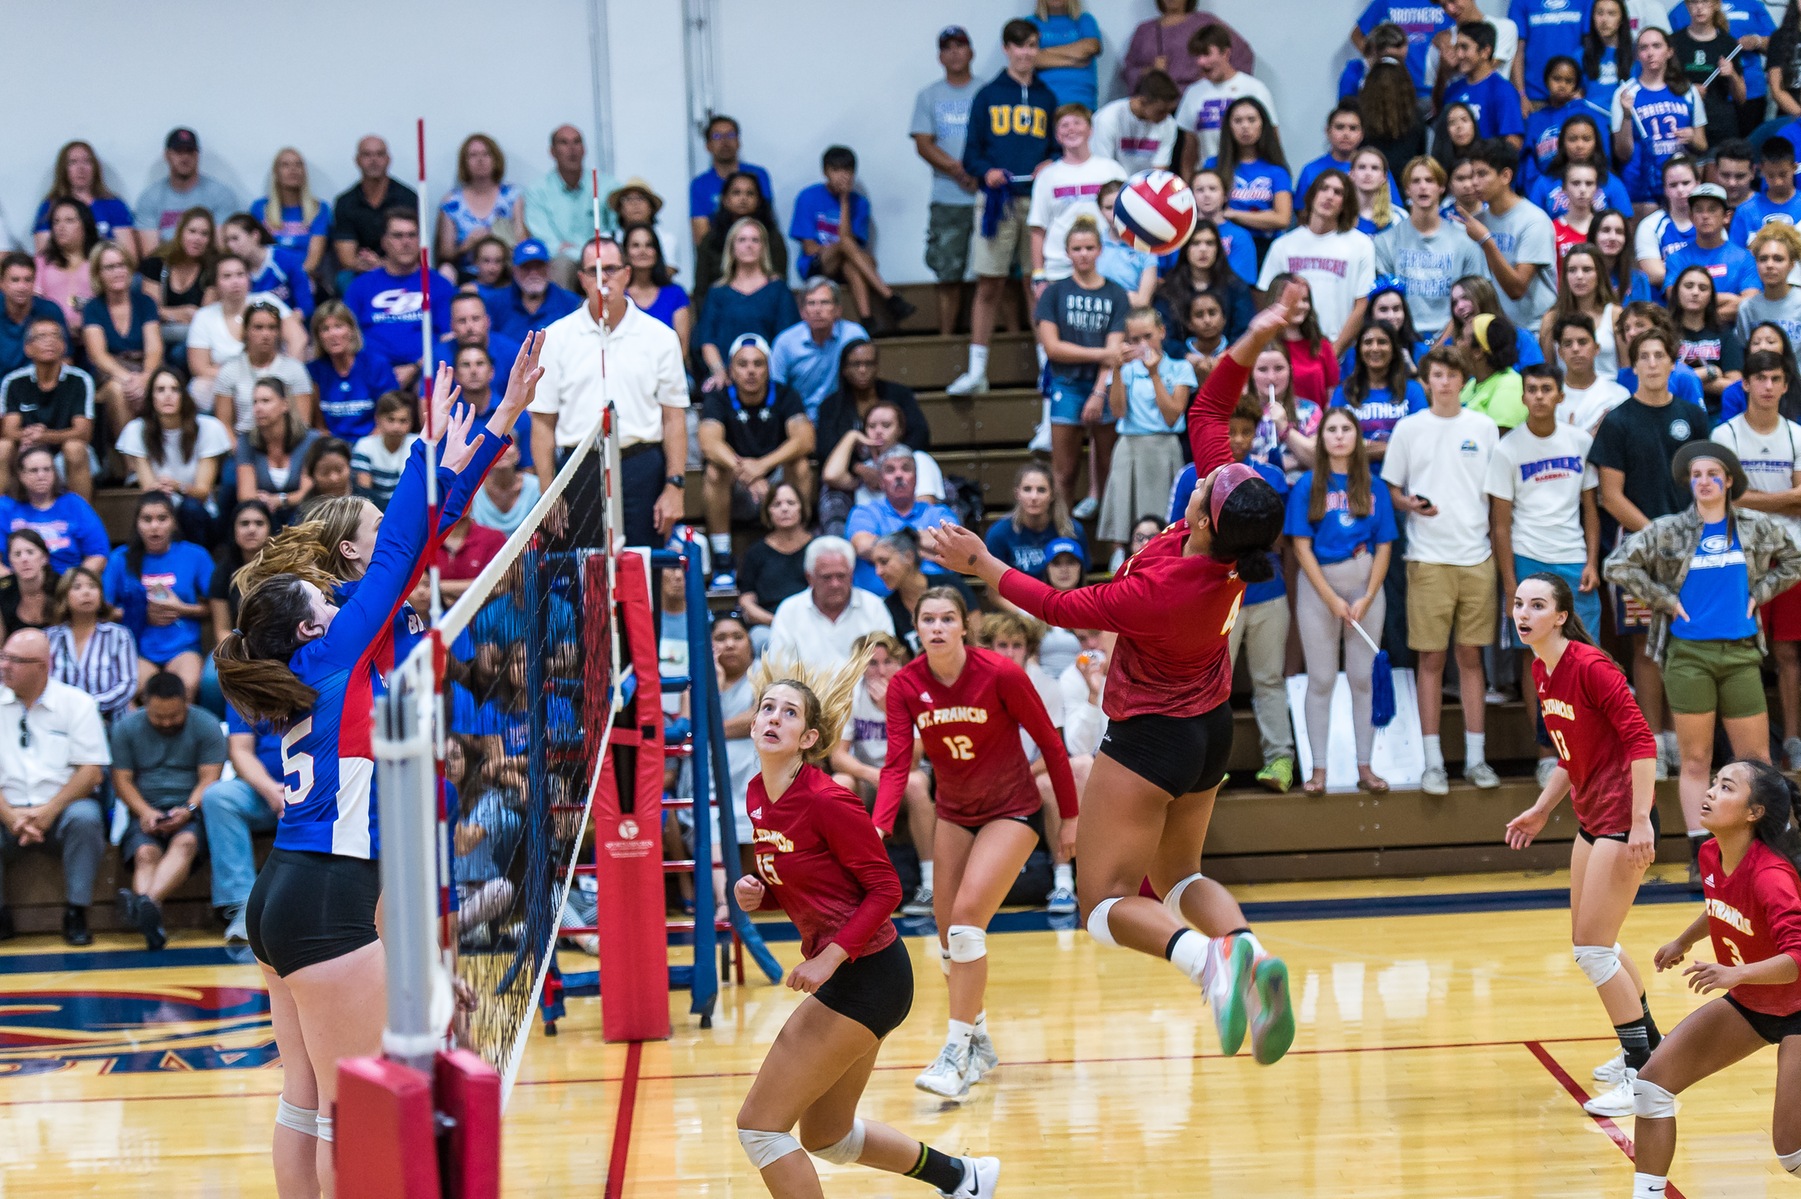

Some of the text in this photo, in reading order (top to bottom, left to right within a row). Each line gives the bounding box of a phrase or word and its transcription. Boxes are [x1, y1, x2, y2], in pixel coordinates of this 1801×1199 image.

[988, 104, 1047, 139] UCD
[1650, 115, 1678, 140] 13
[1066, 294, 1113, 315] OCEAN
[1520, 456, 1583, 482] BROTHERS
[917, 706, 988, 730] ST. FRANCIS
[281, 715, 315, 805] 5
[942, 735, 975, 760] 12
[1550, 730, 1571, 761] 13
[756, 853, 784, 885] 15
[1711, 898, 1755, 936] FRANCIS
[1722, 937, 1746, 967] 3
